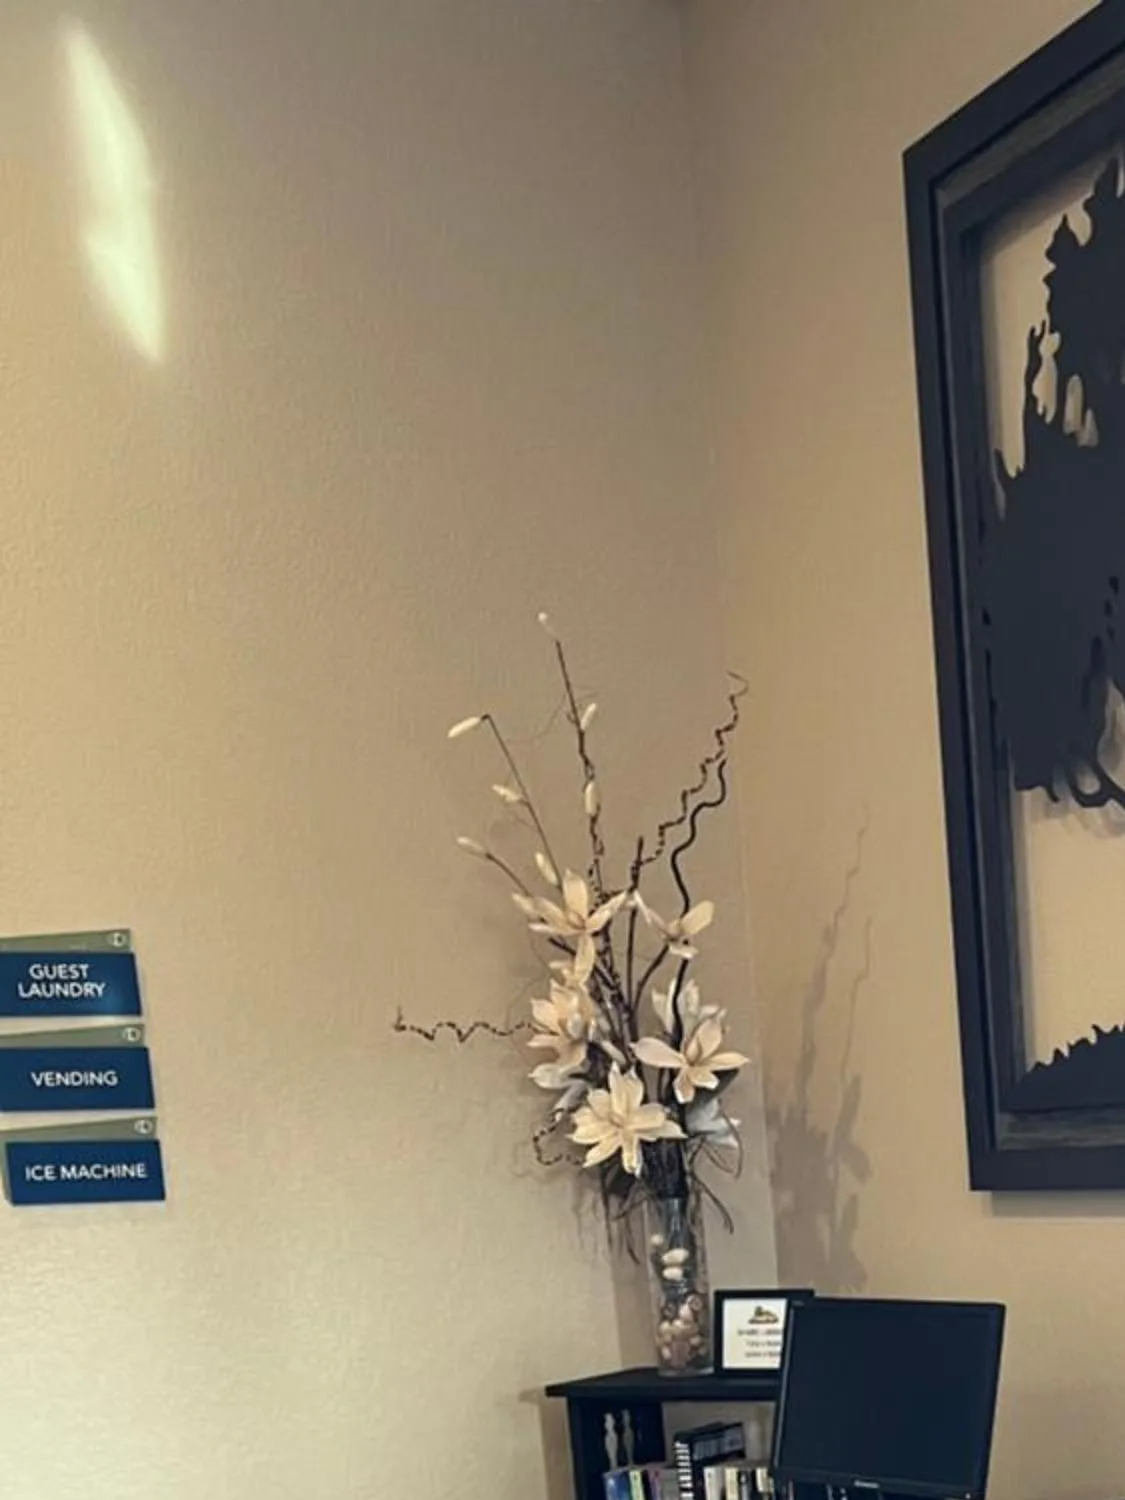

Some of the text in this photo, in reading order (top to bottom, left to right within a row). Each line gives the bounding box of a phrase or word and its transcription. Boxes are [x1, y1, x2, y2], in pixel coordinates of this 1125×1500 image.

[28, 963, 90, 980] GUEST
[18, 982, 107, 999] LAUNDRY
[30, 1070, 120, 1088] VENDING
[25, 1162, 149, 1182] ICE MACHINE
